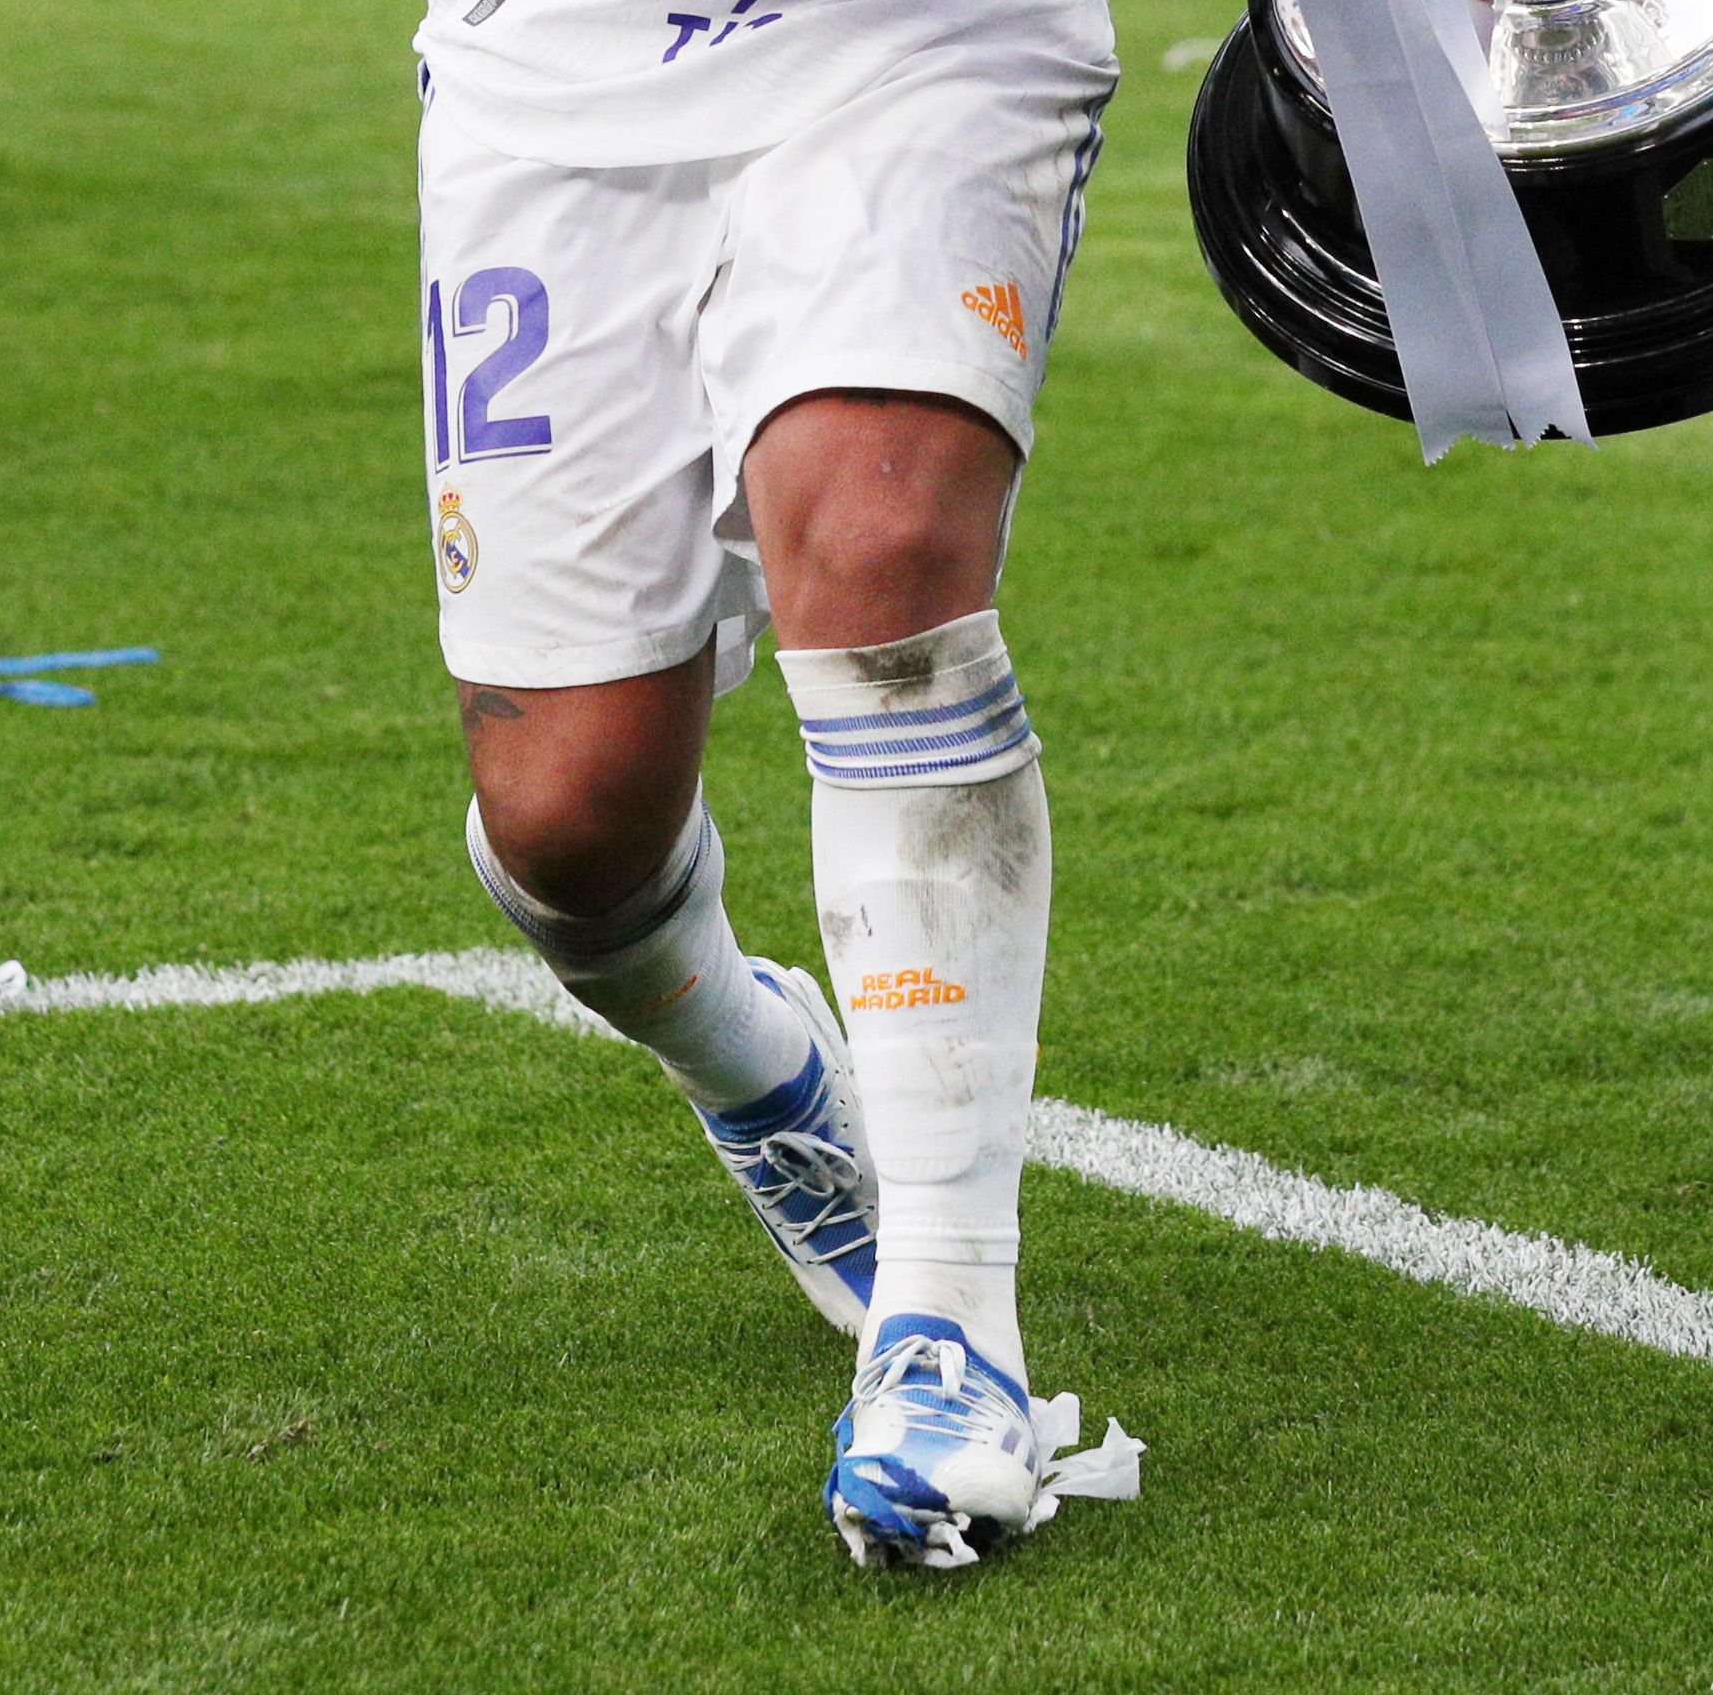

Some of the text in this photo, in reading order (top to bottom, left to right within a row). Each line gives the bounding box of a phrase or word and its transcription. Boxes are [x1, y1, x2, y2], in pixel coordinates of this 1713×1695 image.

[960, 290, 1028, 361] adidas
[427, 266, 553, 474] 12
[849, 983, 966, 1011] MADRID
[862, 967, 943, 991] REAL
